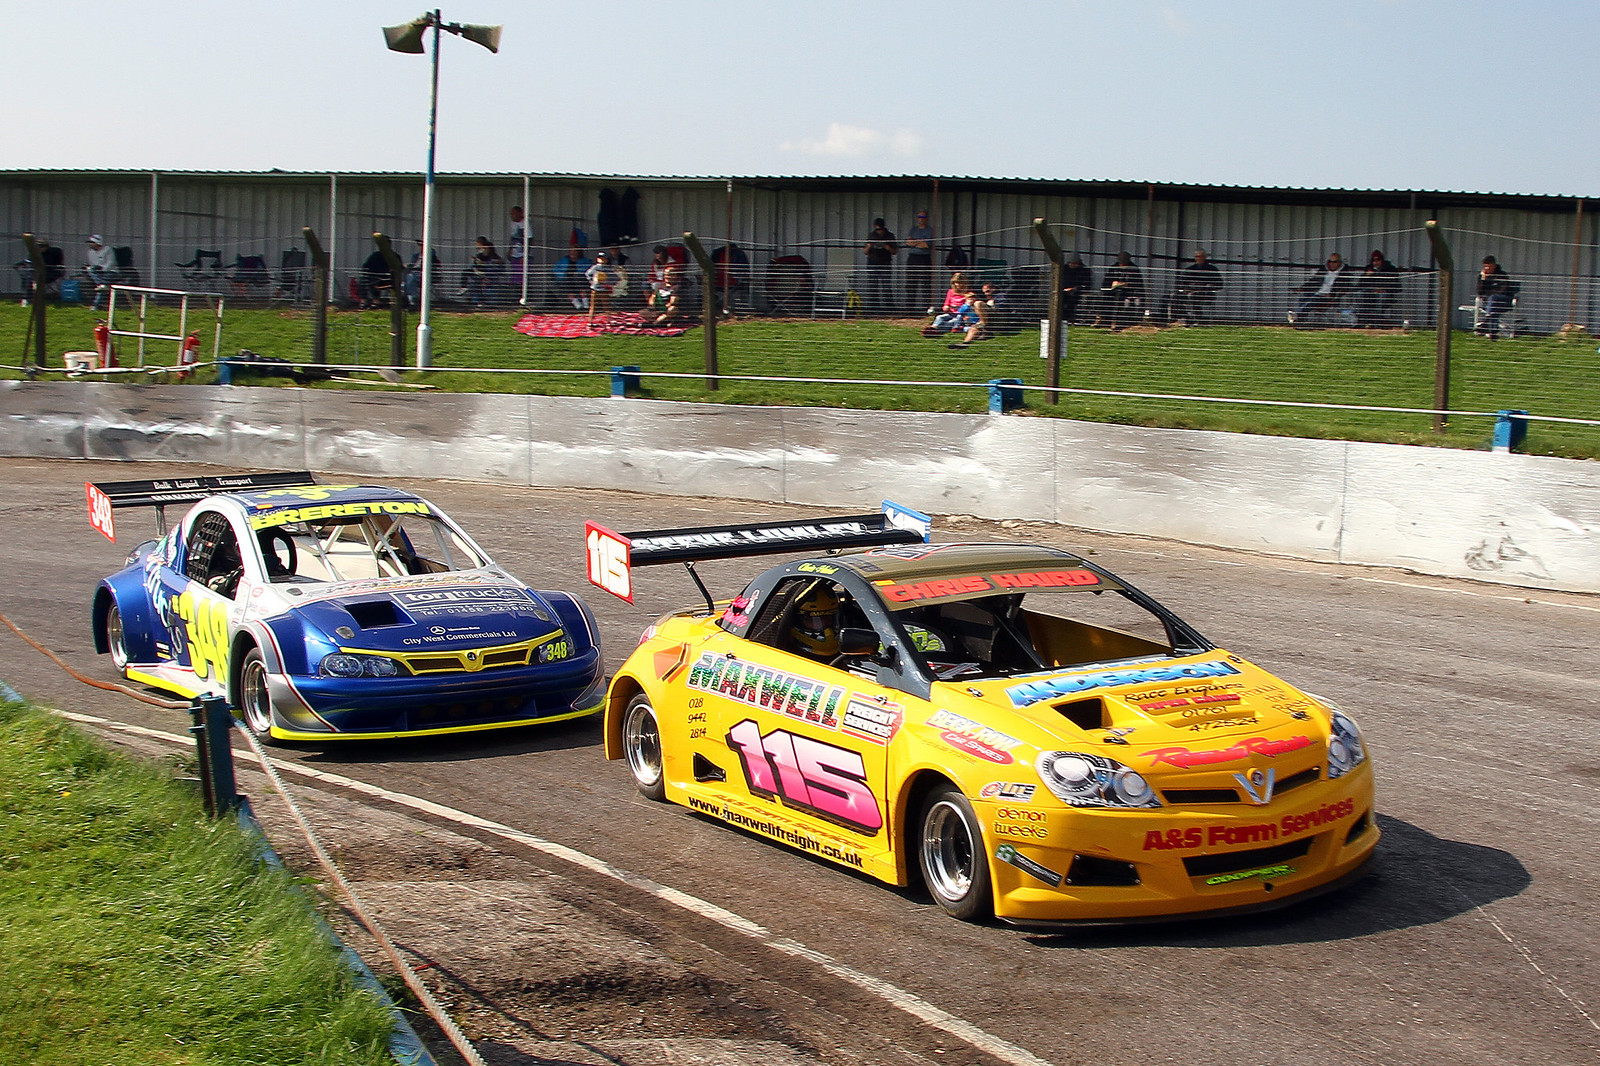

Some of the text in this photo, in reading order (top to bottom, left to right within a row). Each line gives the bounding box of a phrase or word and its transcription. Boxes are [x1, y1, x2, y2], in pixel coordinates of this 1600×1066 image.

[153, 477, 253, 489] Bulk Liquid Transport
[89, 486, 114, 538] 348
[250, 502, 431, 530] BRERETON
[587, 529, 631, 598] 115
[881, 569, 1102, 602] CHRIS HAIRD
[403, 630, 517, 645] City West Commercials Ltd
[547, 641, 567, 661] 348
[687, 652, 845, 731] MAXWELL
[1005, 661, 1242, 708] ANDERSON
[1125, 689, 1168, 703] Race
[1174, 684, 1245, 697] Engines
[689, 698, 704, 708] 028
[846, 703, 897, 725] FREIGHT
[690, 727, 707, 739] 2814
[843, 714, 892, 738] SERVICES
[965, 741, 1006, 761] SPARES
[726, 718, 883, 837] 115
[997, 807, 1047, 822] demon
[1142, 798, 1354, 850] A&S Farm Services
[688, 796, 865, 869] www.maxwellfreight.co.uk
[994, 822, 1049, 839] tweeks
